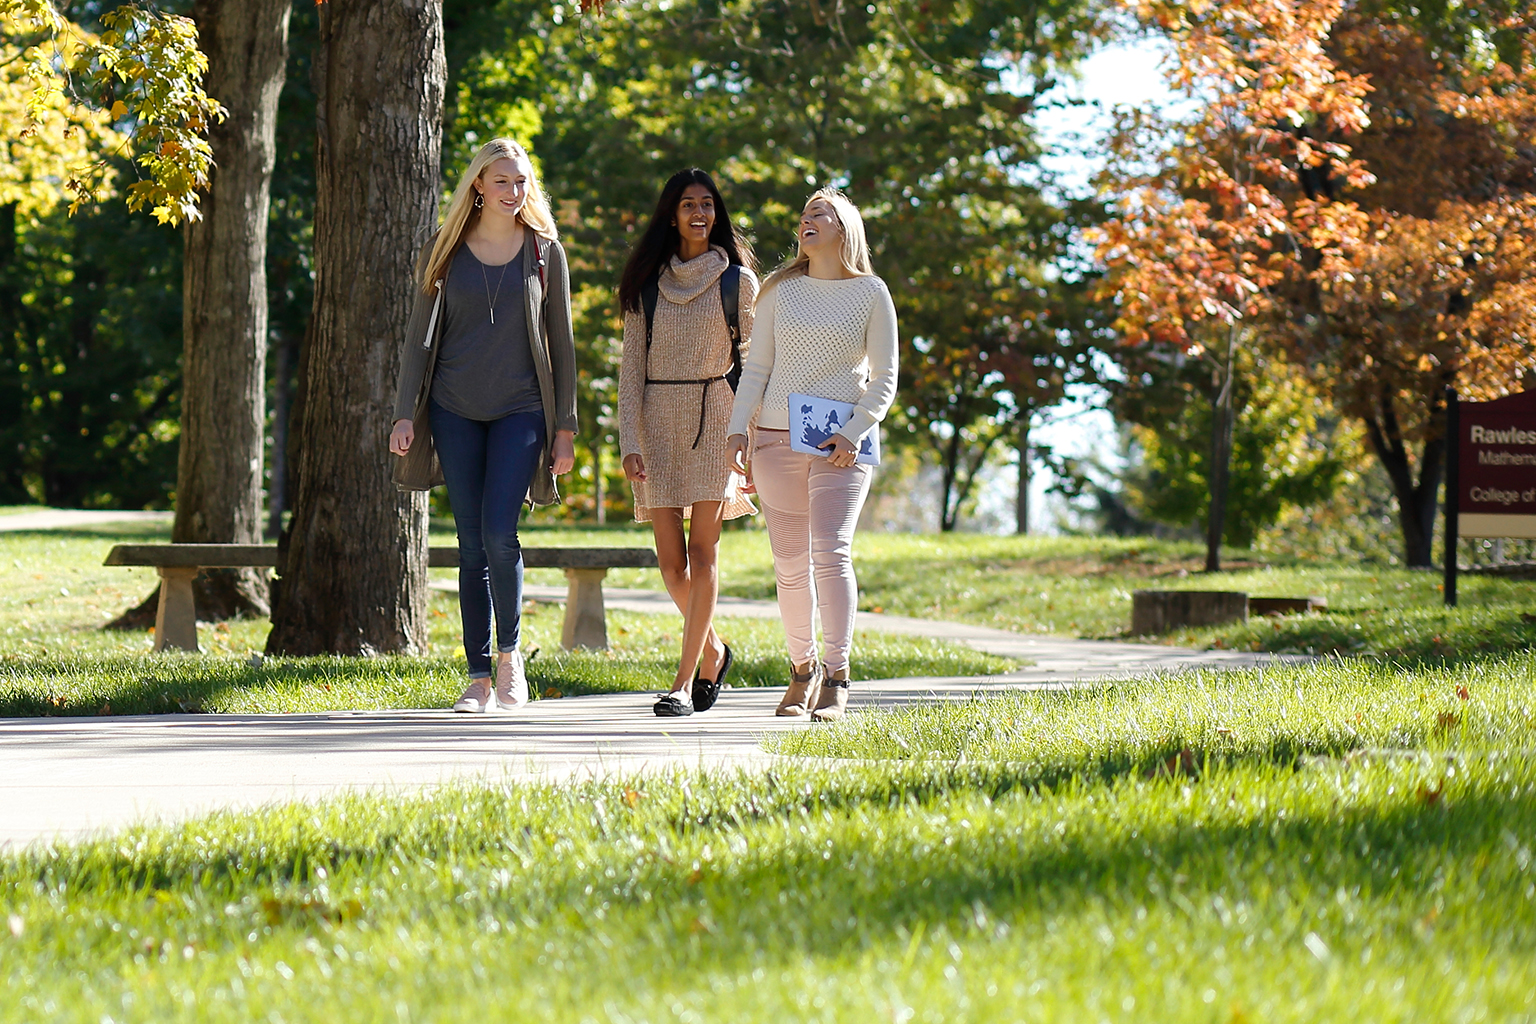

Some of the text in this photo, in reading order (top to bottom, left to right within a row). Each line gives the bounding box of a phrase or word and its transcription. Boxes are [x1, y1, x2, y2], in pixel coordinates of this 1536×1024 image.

[1470, 425, 1536, 445] Rawles
[1470, 486, 1536, 506] College of
